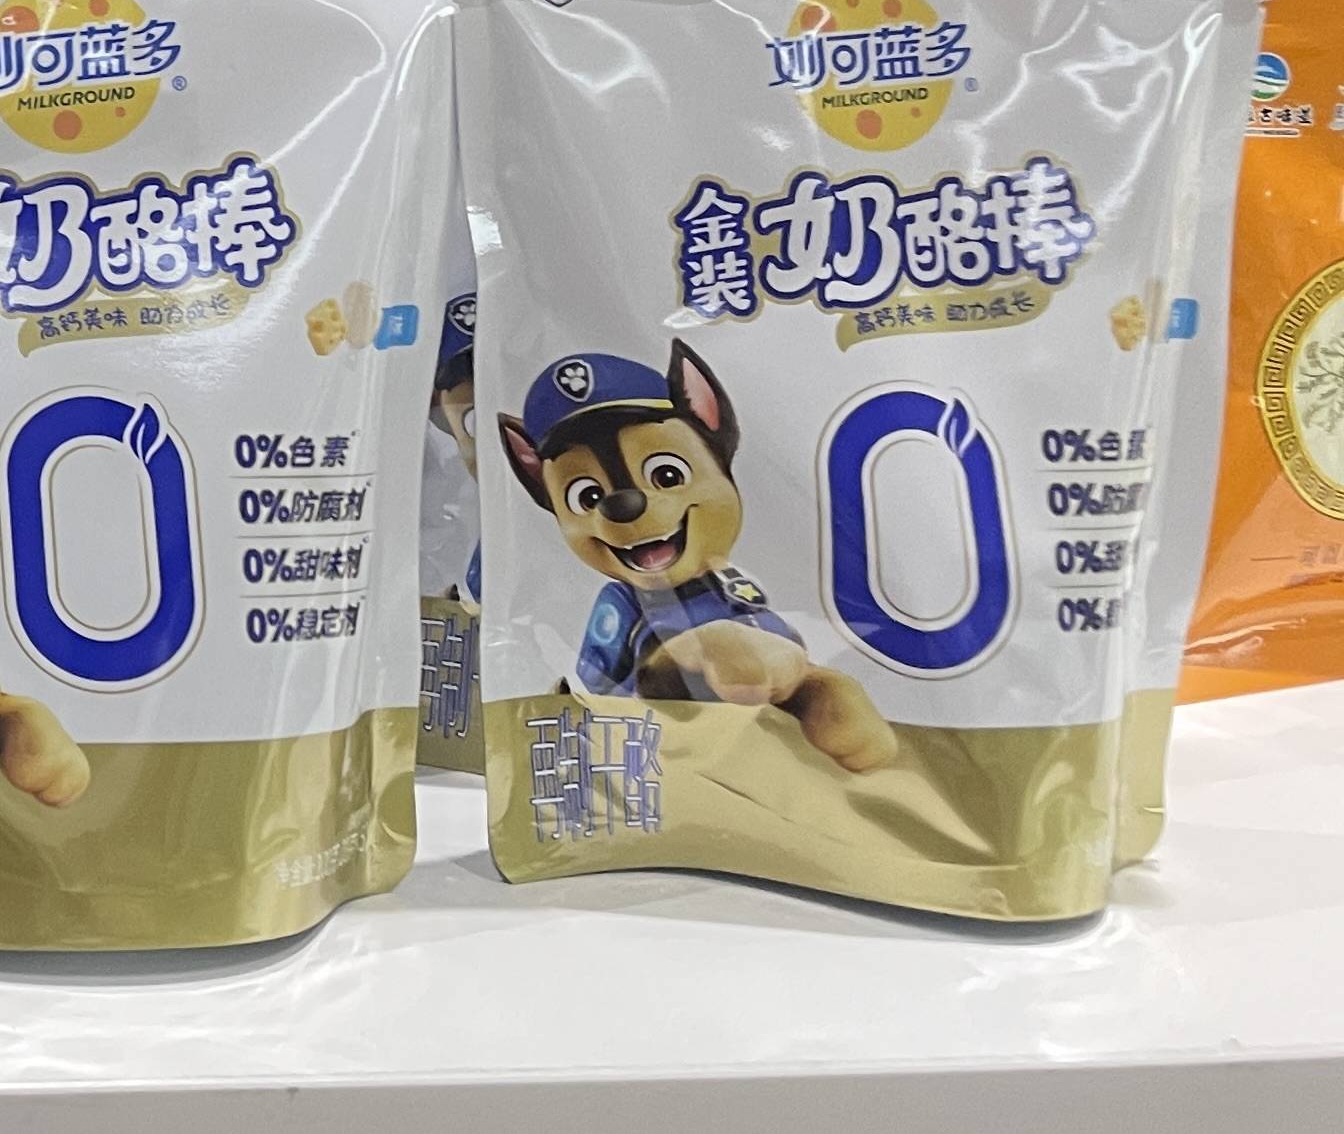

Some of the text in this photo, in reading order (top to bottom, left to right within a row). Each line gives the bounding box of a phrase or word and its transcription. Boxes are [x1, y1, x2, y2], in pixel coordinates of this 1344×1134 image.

[766, 22, 973, 88] 妙可蓝多
[16, 86, 137, 112] MILKGROUND
[821, 87, 929, 110] MILKGROUND
[682, 186, 754, 314] 金装
[757, 162, 1094, 304] 奶酪棒
[38, 313, 128, 340] 高钙美味
[853, 306, 935, 336] 高钙美味
[234, 434, 350, 468] 0%色素
[238, 486, 367, 525] 0%防腐剂
[242, 543, 364, 584] 0%甜味剂
[246, 602, 361, 644] 0%稳定剂
